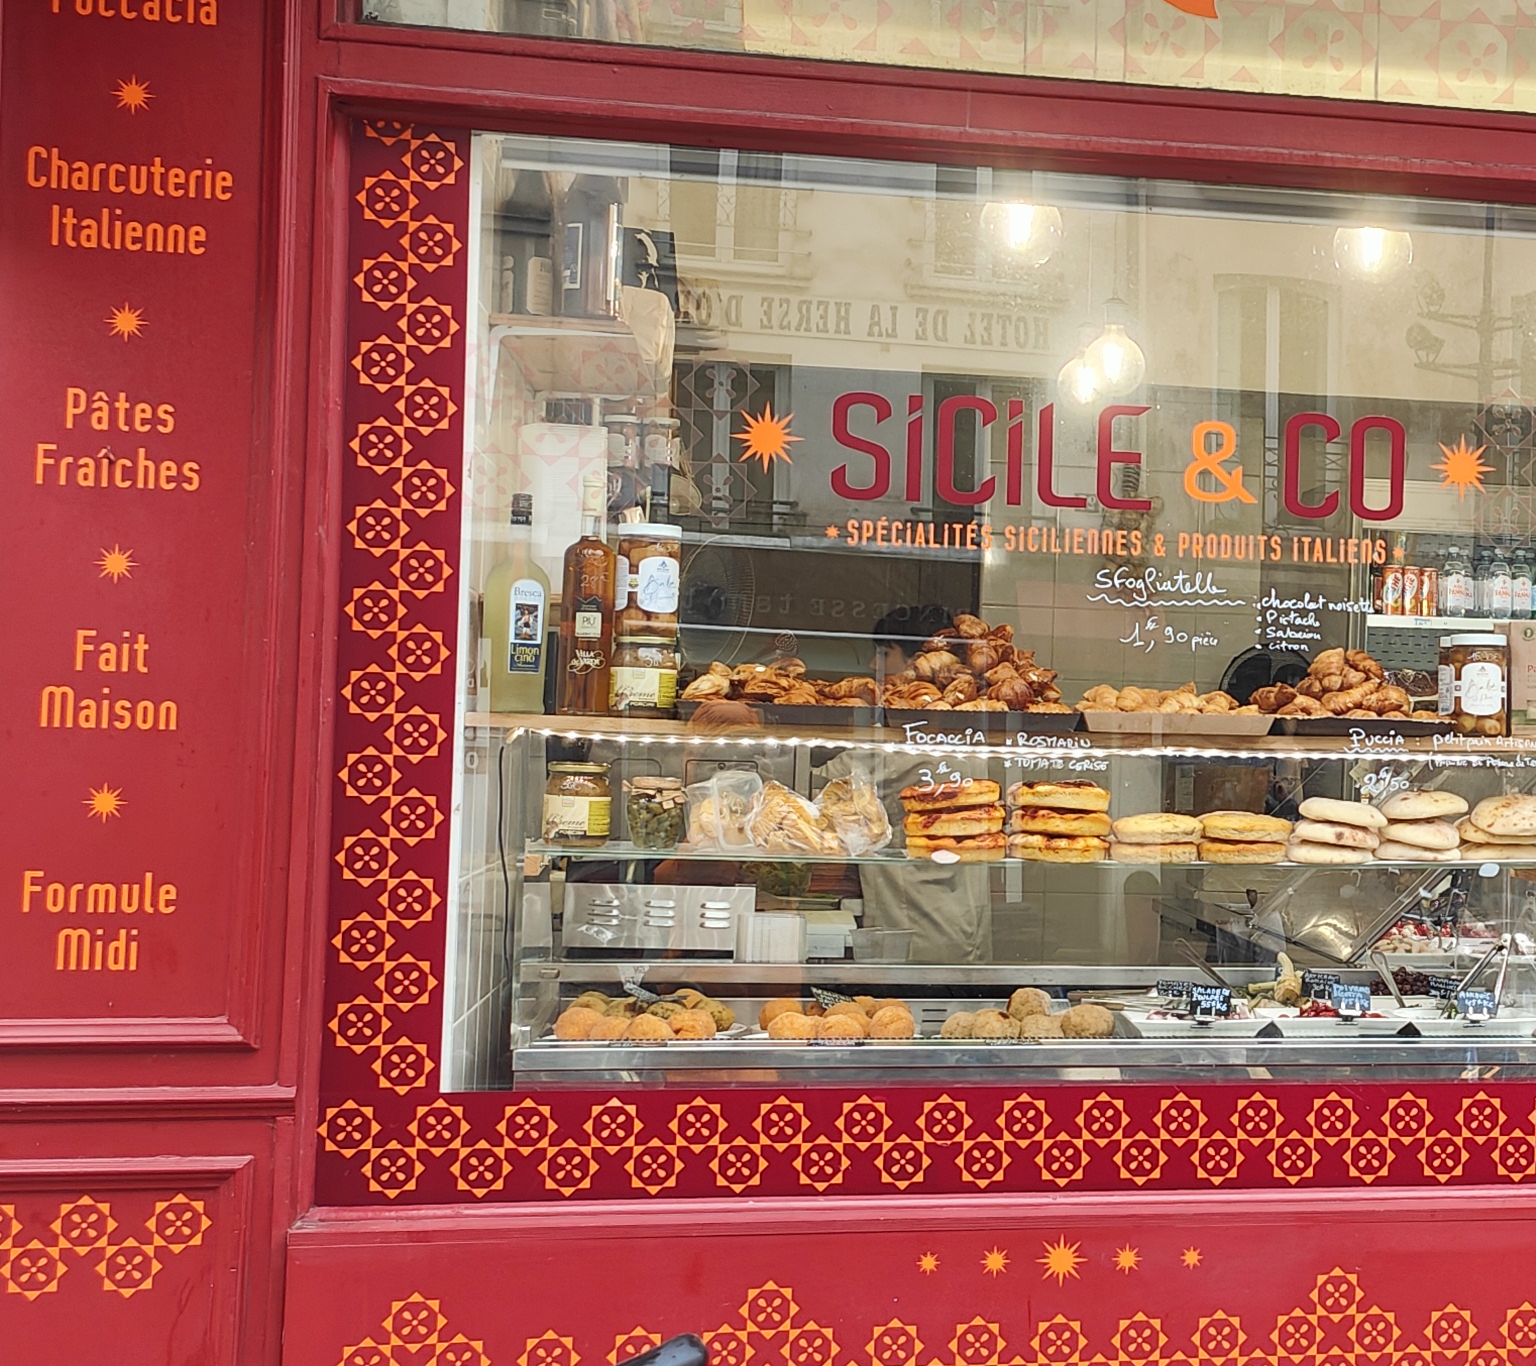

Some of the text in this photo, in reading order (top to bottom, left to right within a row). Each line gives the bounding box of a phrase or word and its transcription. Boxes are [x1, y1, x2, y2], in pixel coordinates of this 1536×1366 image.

[26, 144, 235, 202] Charcuterie
[51, 203, 208, 256] Italienne
[65, 386, 177, 435] Pâtes
[34, 442, 201, 493] Fraîches
[1182, 419, 1259, 505] &
[1282, 411, 1407, 522] CO
[1153, 533, 1167, 558] &
[514, 586, 541, 598] Bresca
[74, 628, 150, 675] Fait
[39, 685, 179, 732] Maison
[21, 870, 179, 916] Formule
[55, 928, 140, 973] Midi
